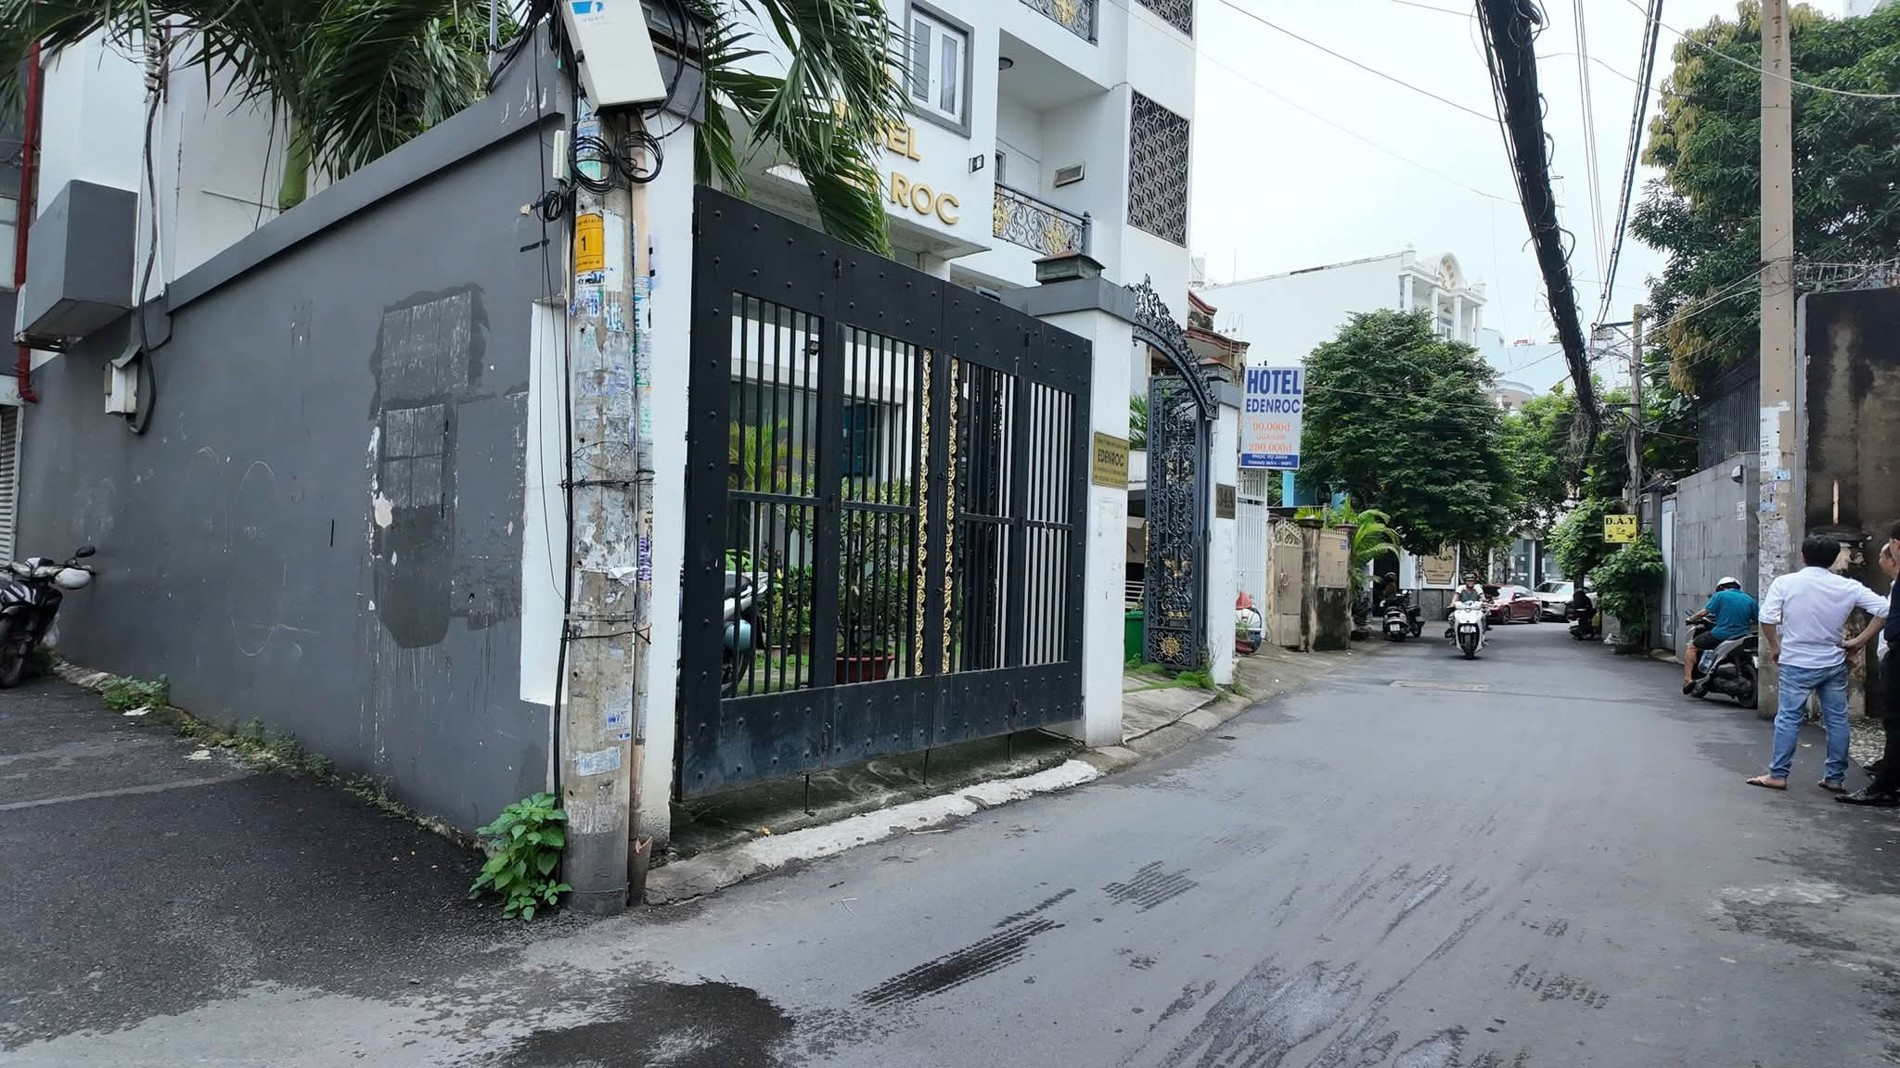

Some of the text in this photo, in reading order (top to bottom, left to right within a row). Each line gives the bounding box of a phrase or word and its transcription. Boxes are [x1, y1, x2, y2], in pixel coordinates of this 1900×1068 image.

[891, 171, 959, 225] ROC
[1247, 370, 1301, 394] HOTEL
[1246, 398, 1300, 413] EDENROC
[1097, 448, 1124, 467] EDENROC
